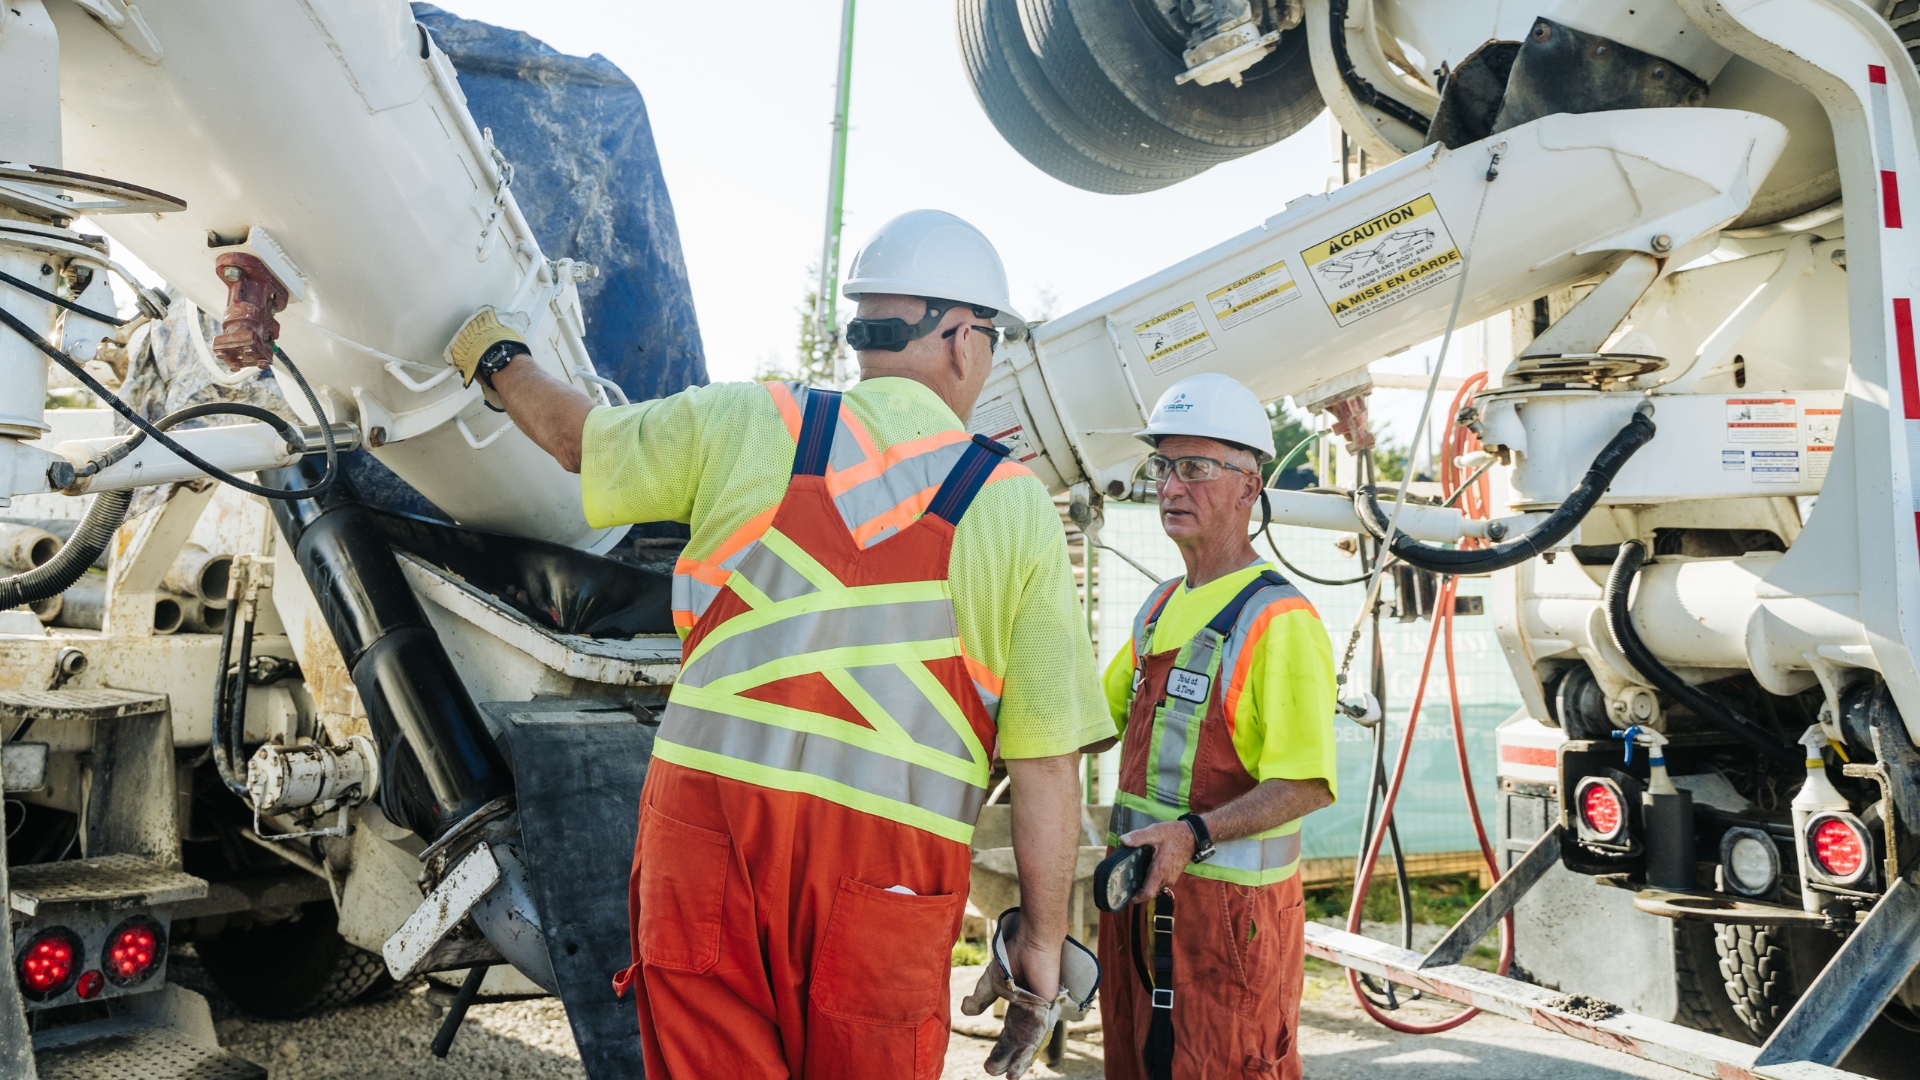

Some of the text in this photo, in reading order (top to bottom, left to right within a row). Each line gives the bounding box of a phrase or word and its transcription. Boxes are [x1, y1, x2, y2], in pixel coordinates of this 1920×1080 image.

[1339, 205, 1414, 248] CAUTION
[1232, 270, 1266, 289] CAUTION
[1338, 243, 1433, 289] KEEP HANDS AND BODY AWAY
[1349, 250, 1457, 305] MISE EN GARDE
[1357, 256, 1421, 289] FROM PIVOT POINTS
[1259, 288, 1278, 300] GARDE
[1339, 304, 1365, 319] GARDER
[1366, 298, 1378, 306] LES
[1380, 288, 1400, 300] MAINS
[1421, 268, 1443, 281] CORPS
[1444, 261, 1460, 271] LOIN
[1357, 308, 1369, 316] DES
[1371, 296, 1394, 310] POINTS
[1406, 273, 1446, 294] PIVOTEMENT
[1151, 307, 1183, 325] CAUTION
[1183, 332, 1205, 345] GARDE
